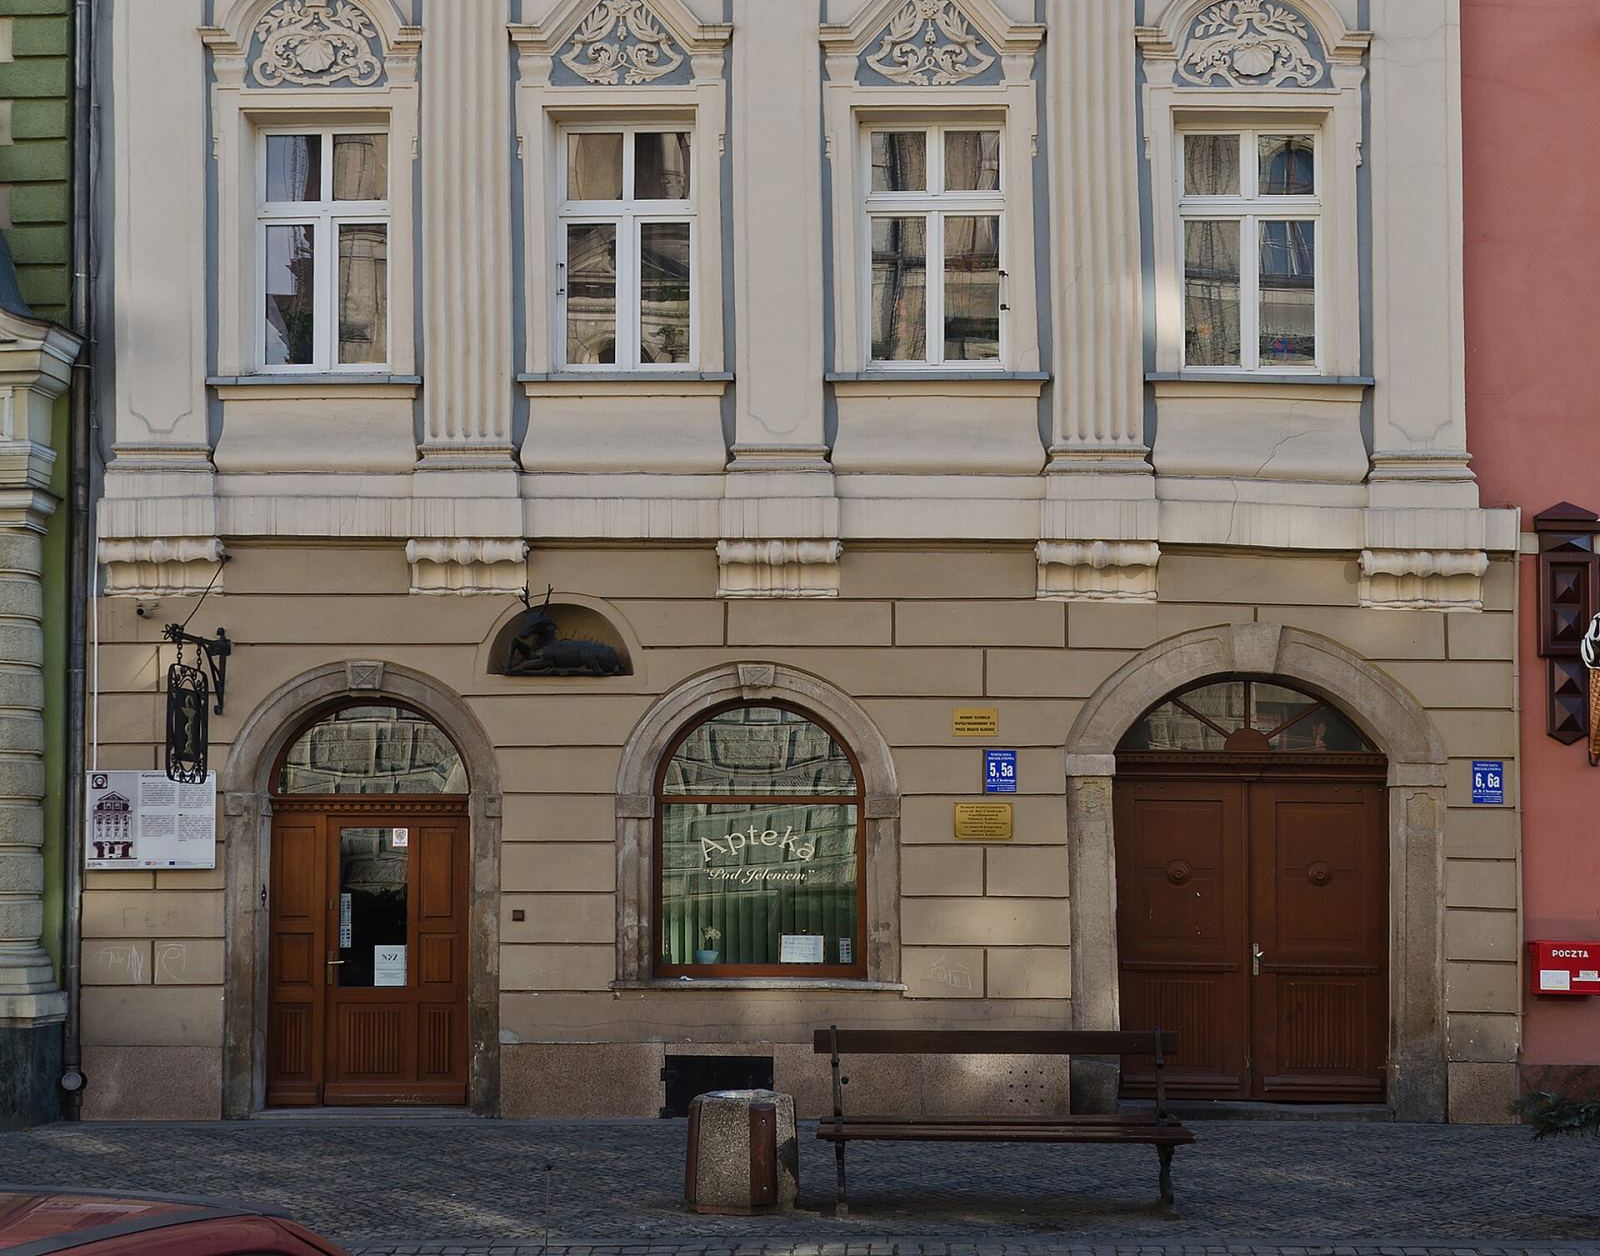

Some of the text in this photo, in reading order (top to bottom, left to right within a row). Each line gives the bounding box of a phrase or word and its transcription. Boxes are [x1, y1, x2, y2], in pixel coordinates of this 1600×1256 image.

[989, 762, 1013, 778] 5, 5a
[1475, 772, 1500, 789] 6, 6a
[700, 824, 816, 862] Apteka
[1552, 949, 1589, 958] POCZTA
